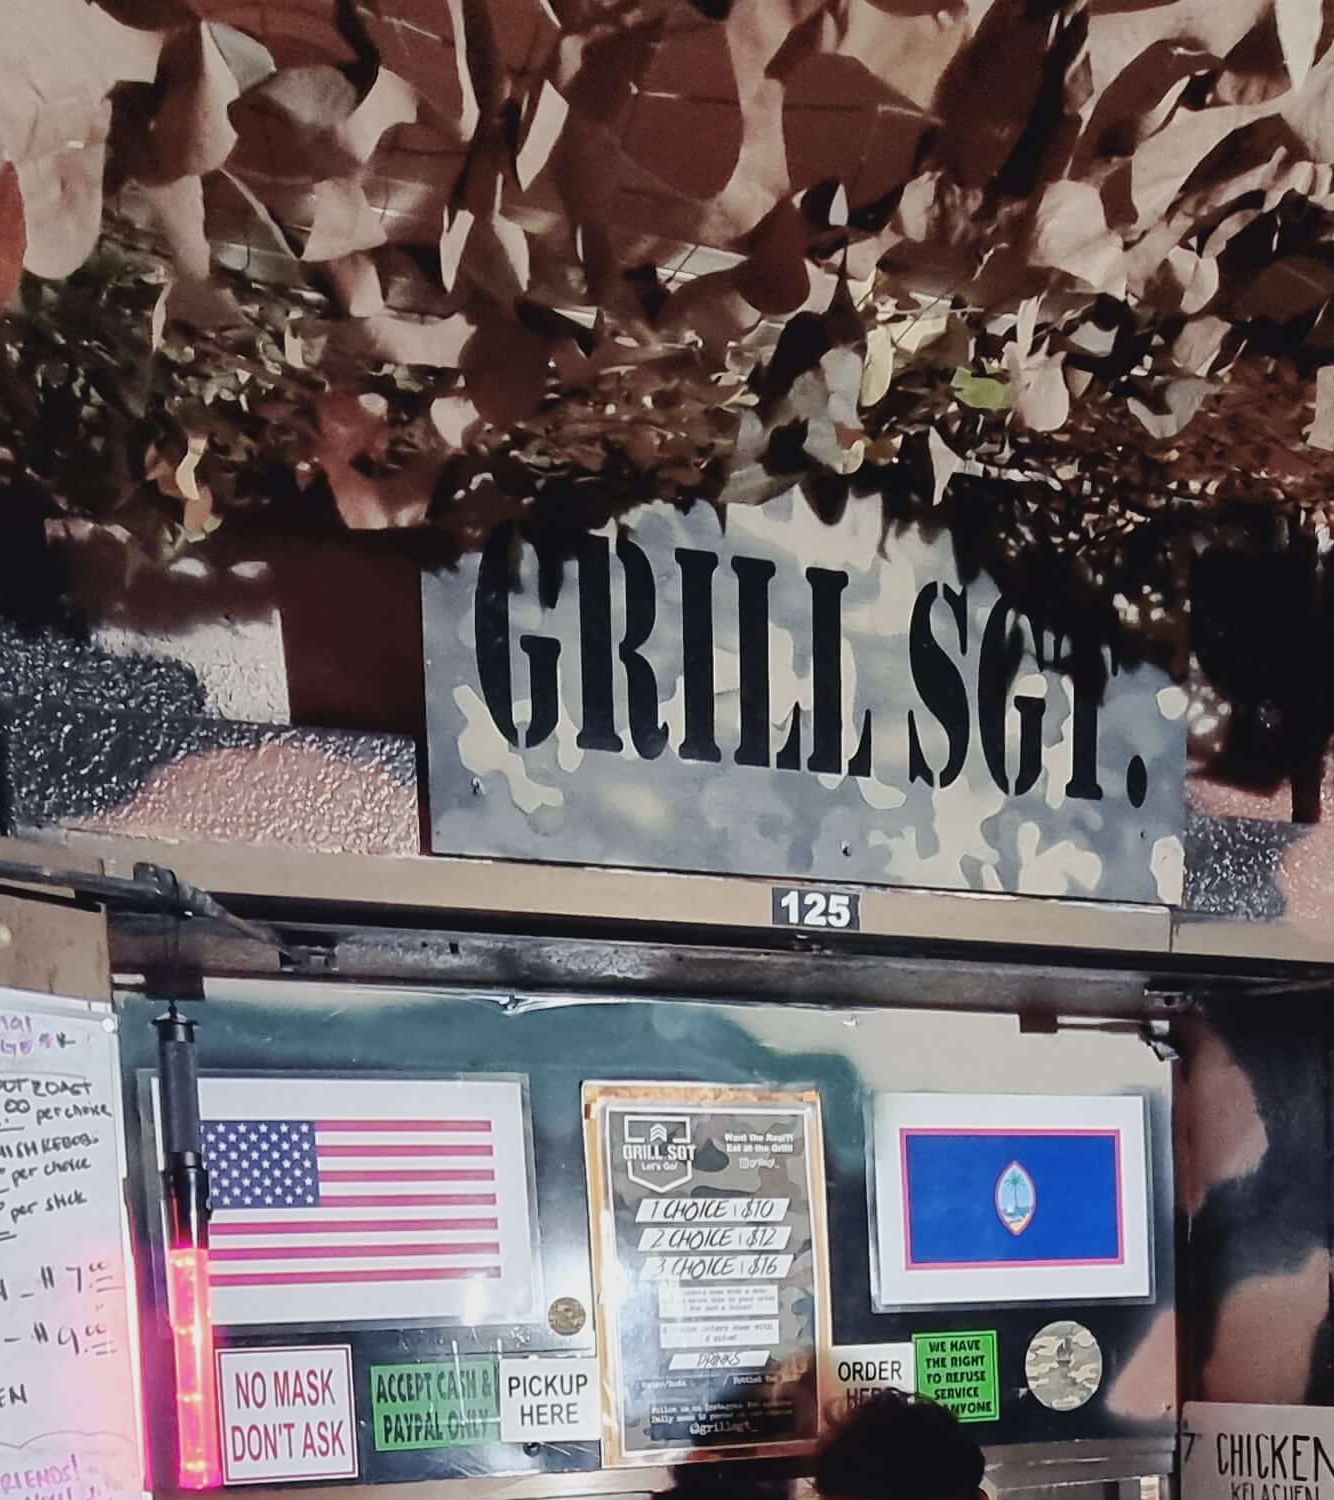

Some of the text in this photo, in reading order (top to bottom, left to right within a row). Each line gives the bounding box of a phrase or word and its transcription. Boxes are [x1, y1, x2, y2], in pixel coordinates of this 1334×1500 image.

[474, 525, 872, 778] GRILL
[780, 891, 853, 927] 125
[36, 1106, 61, 1126] per
[623, 1145, 696, 1161] GRILL SGT
[11, 1168, 38, 1187] per
[10, 1202, 38, 1225] per
[45, 1190, 88, 1212] stick
[651, 1199, 774, 1221] 1 CHOICE $10
[652, 1227, 774, 1250] 2 CHOICE $12
[671, 1254, 734, 1278] CHOICE
[748, 1254, 778, 1275] $16
[928, 1339, 981, 1353] WE HAVE
[838, 1361, 903, 1382] ORDER
[925, 1354, 985, 1368] THE RIGHT
[235, 1368, 335, 1409] NO MASK
[377, 1369, 492, 1403] ACCEPT CASH &
[508, 1373, 588, 1398] PICKUP
[926, 1370, 986, 1384] TO REFUSE
[933, 1387, 979, 1400] SERVICE
[520, 1403, 580, 1426] HERE
[383, 1410, 489, 1444] PAYPAL ONLY
[231, 1421, 347, 1462] DON'T ASK
